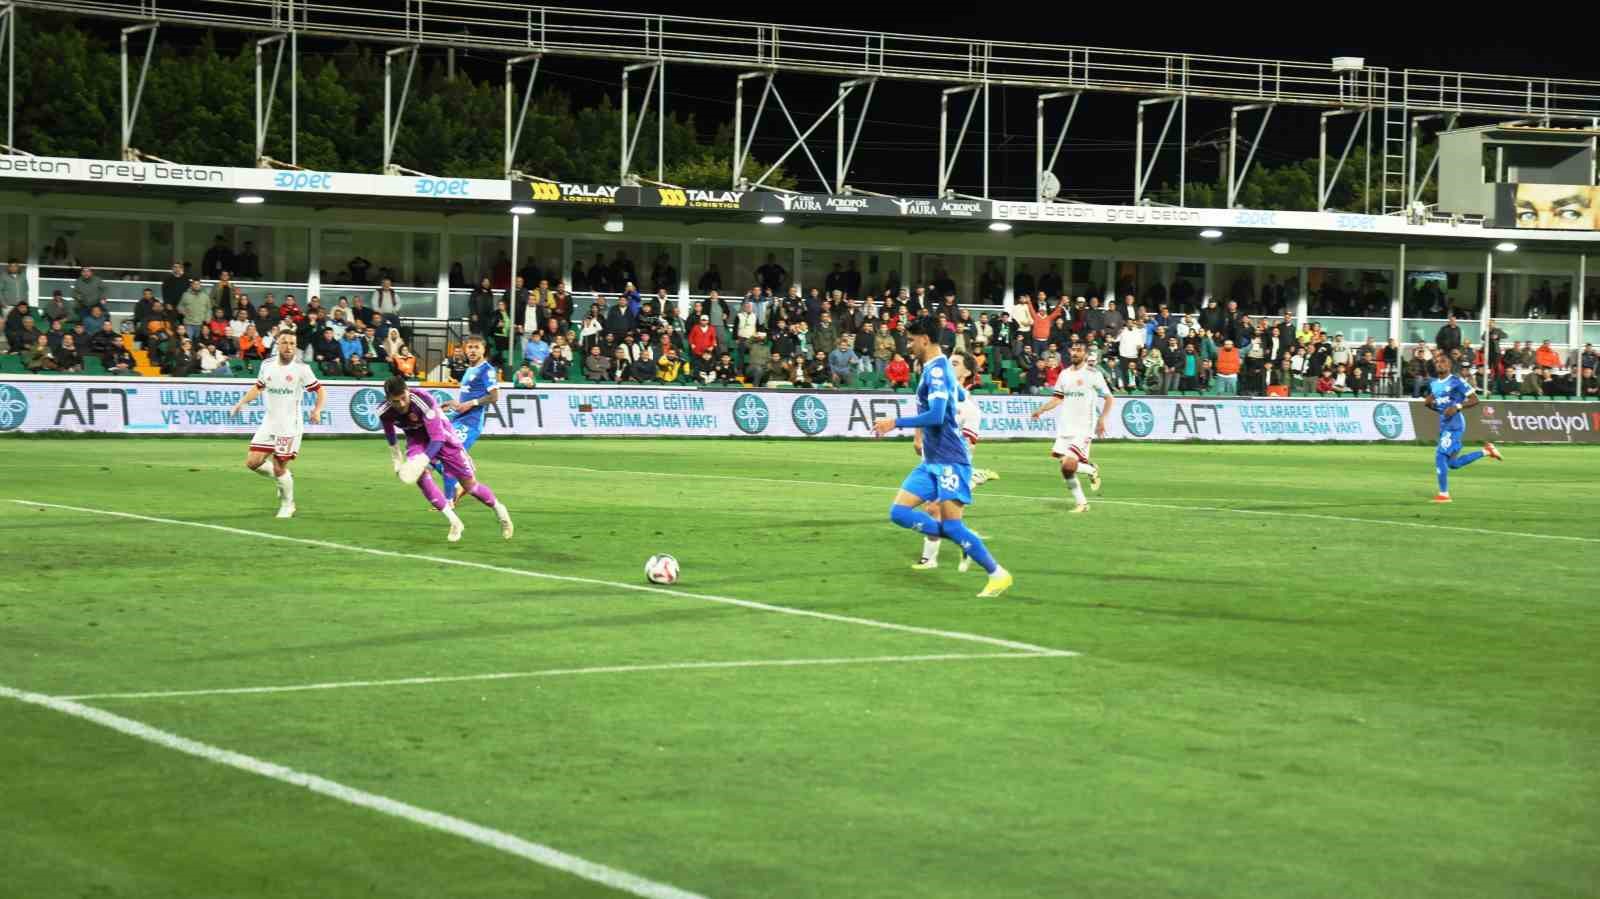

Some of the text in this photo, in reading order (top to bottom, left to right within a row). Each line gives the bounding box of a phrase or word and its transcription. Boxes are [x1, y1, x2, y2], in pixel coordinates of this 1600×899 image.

[89, 162, 224, 182] grey beton
[274, 172, 333, 191] opet
[415, 178, 471, 196] opet
[559, 183, 620, 198] TALAY
[686, 189, 745, 203] TALAY
[792, 200, 822, 211] AURA
[910, 205, 937, 216] AURA
[998, 204, 1097, 219] grey beton
[1106, 207, 1200, 223] grey beton
[54, 387, 137, 426] AFT
[483, 393, 549, 428] AFT
[162, 409, 181, 426] VE
[569, 413, 589, 428] VE
[684, 413, 718, 430] VAKFI
[1172, 402, 1224, 435] AFT
[1506, 410, 1590, 435] trendyol
[1241, 421, 1257, 434] VE
